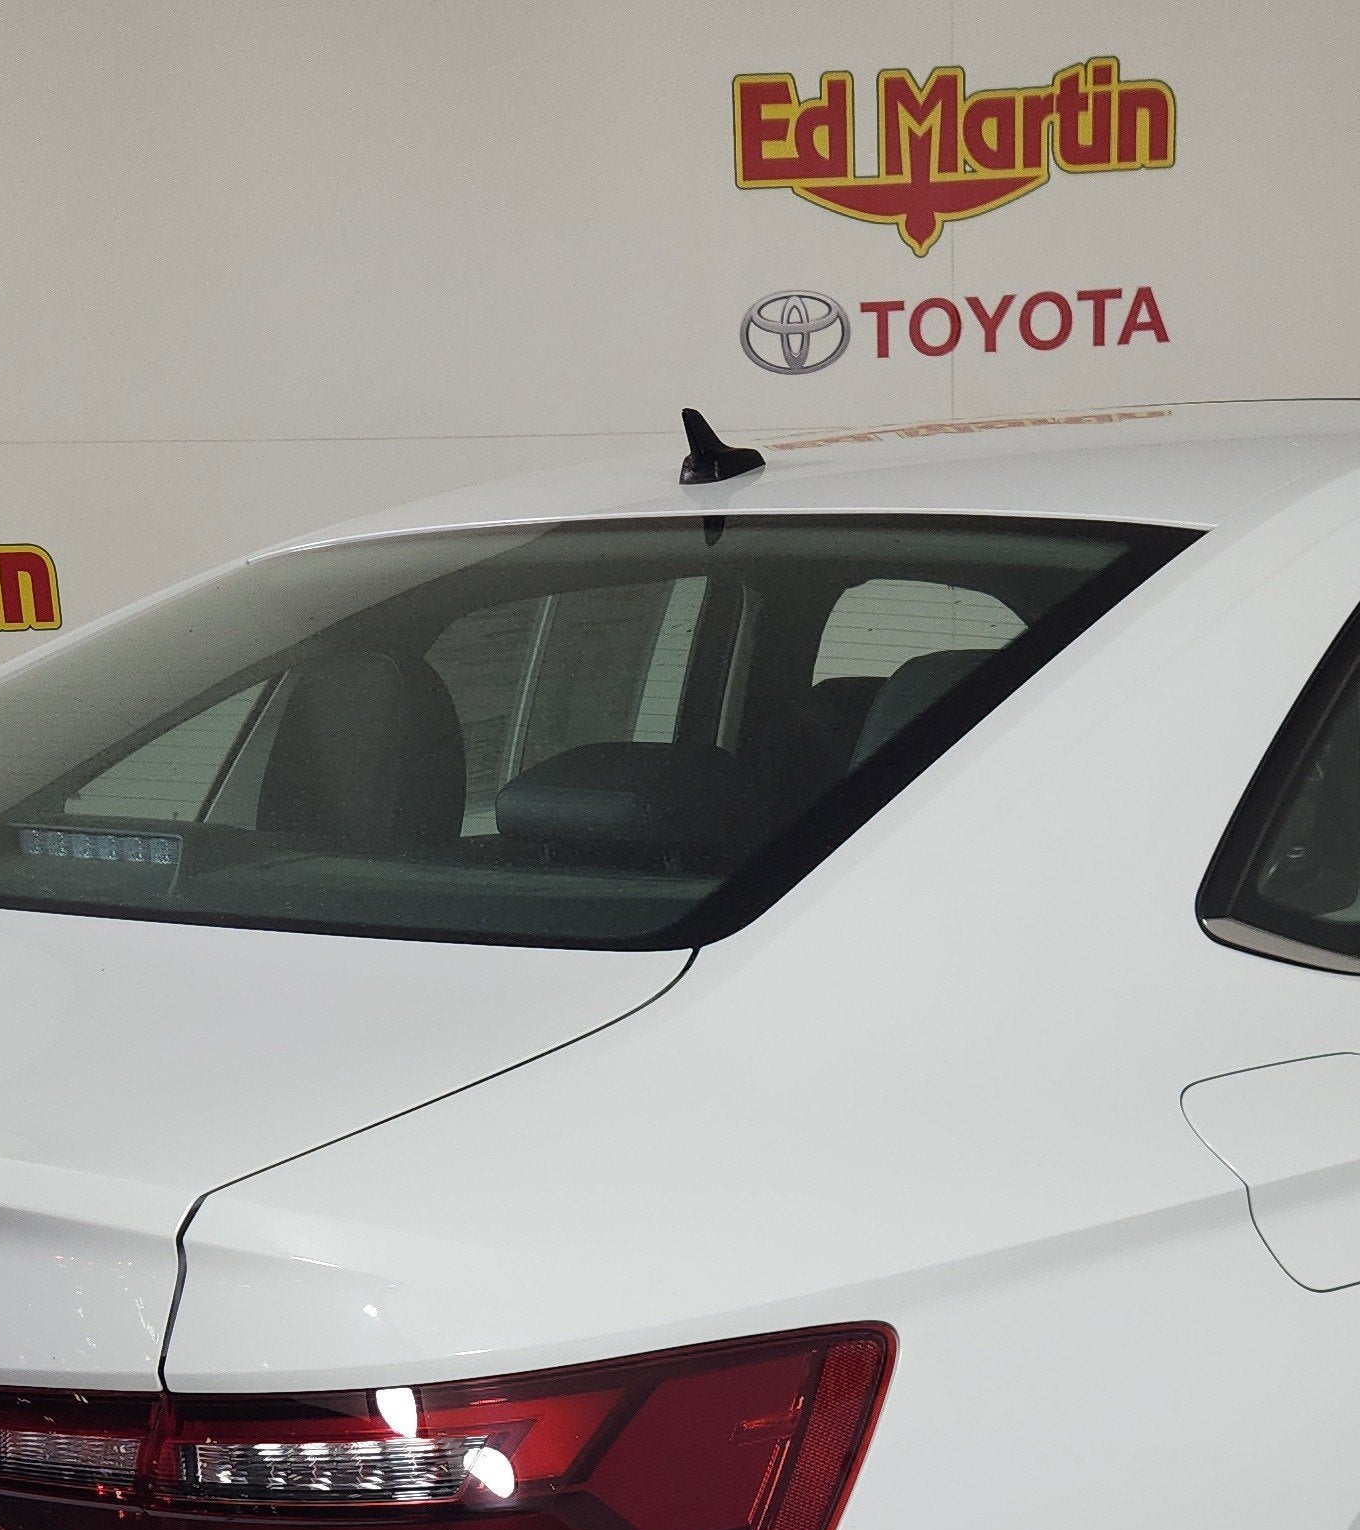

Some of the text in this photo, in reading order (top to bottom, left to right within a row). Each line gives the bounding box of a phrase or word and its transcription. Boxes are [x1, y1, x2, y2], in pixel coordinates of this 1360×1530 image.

[733, 56, 1176, 189] Ed Martin
[860, 286, 1170, 359] TOYOTA
